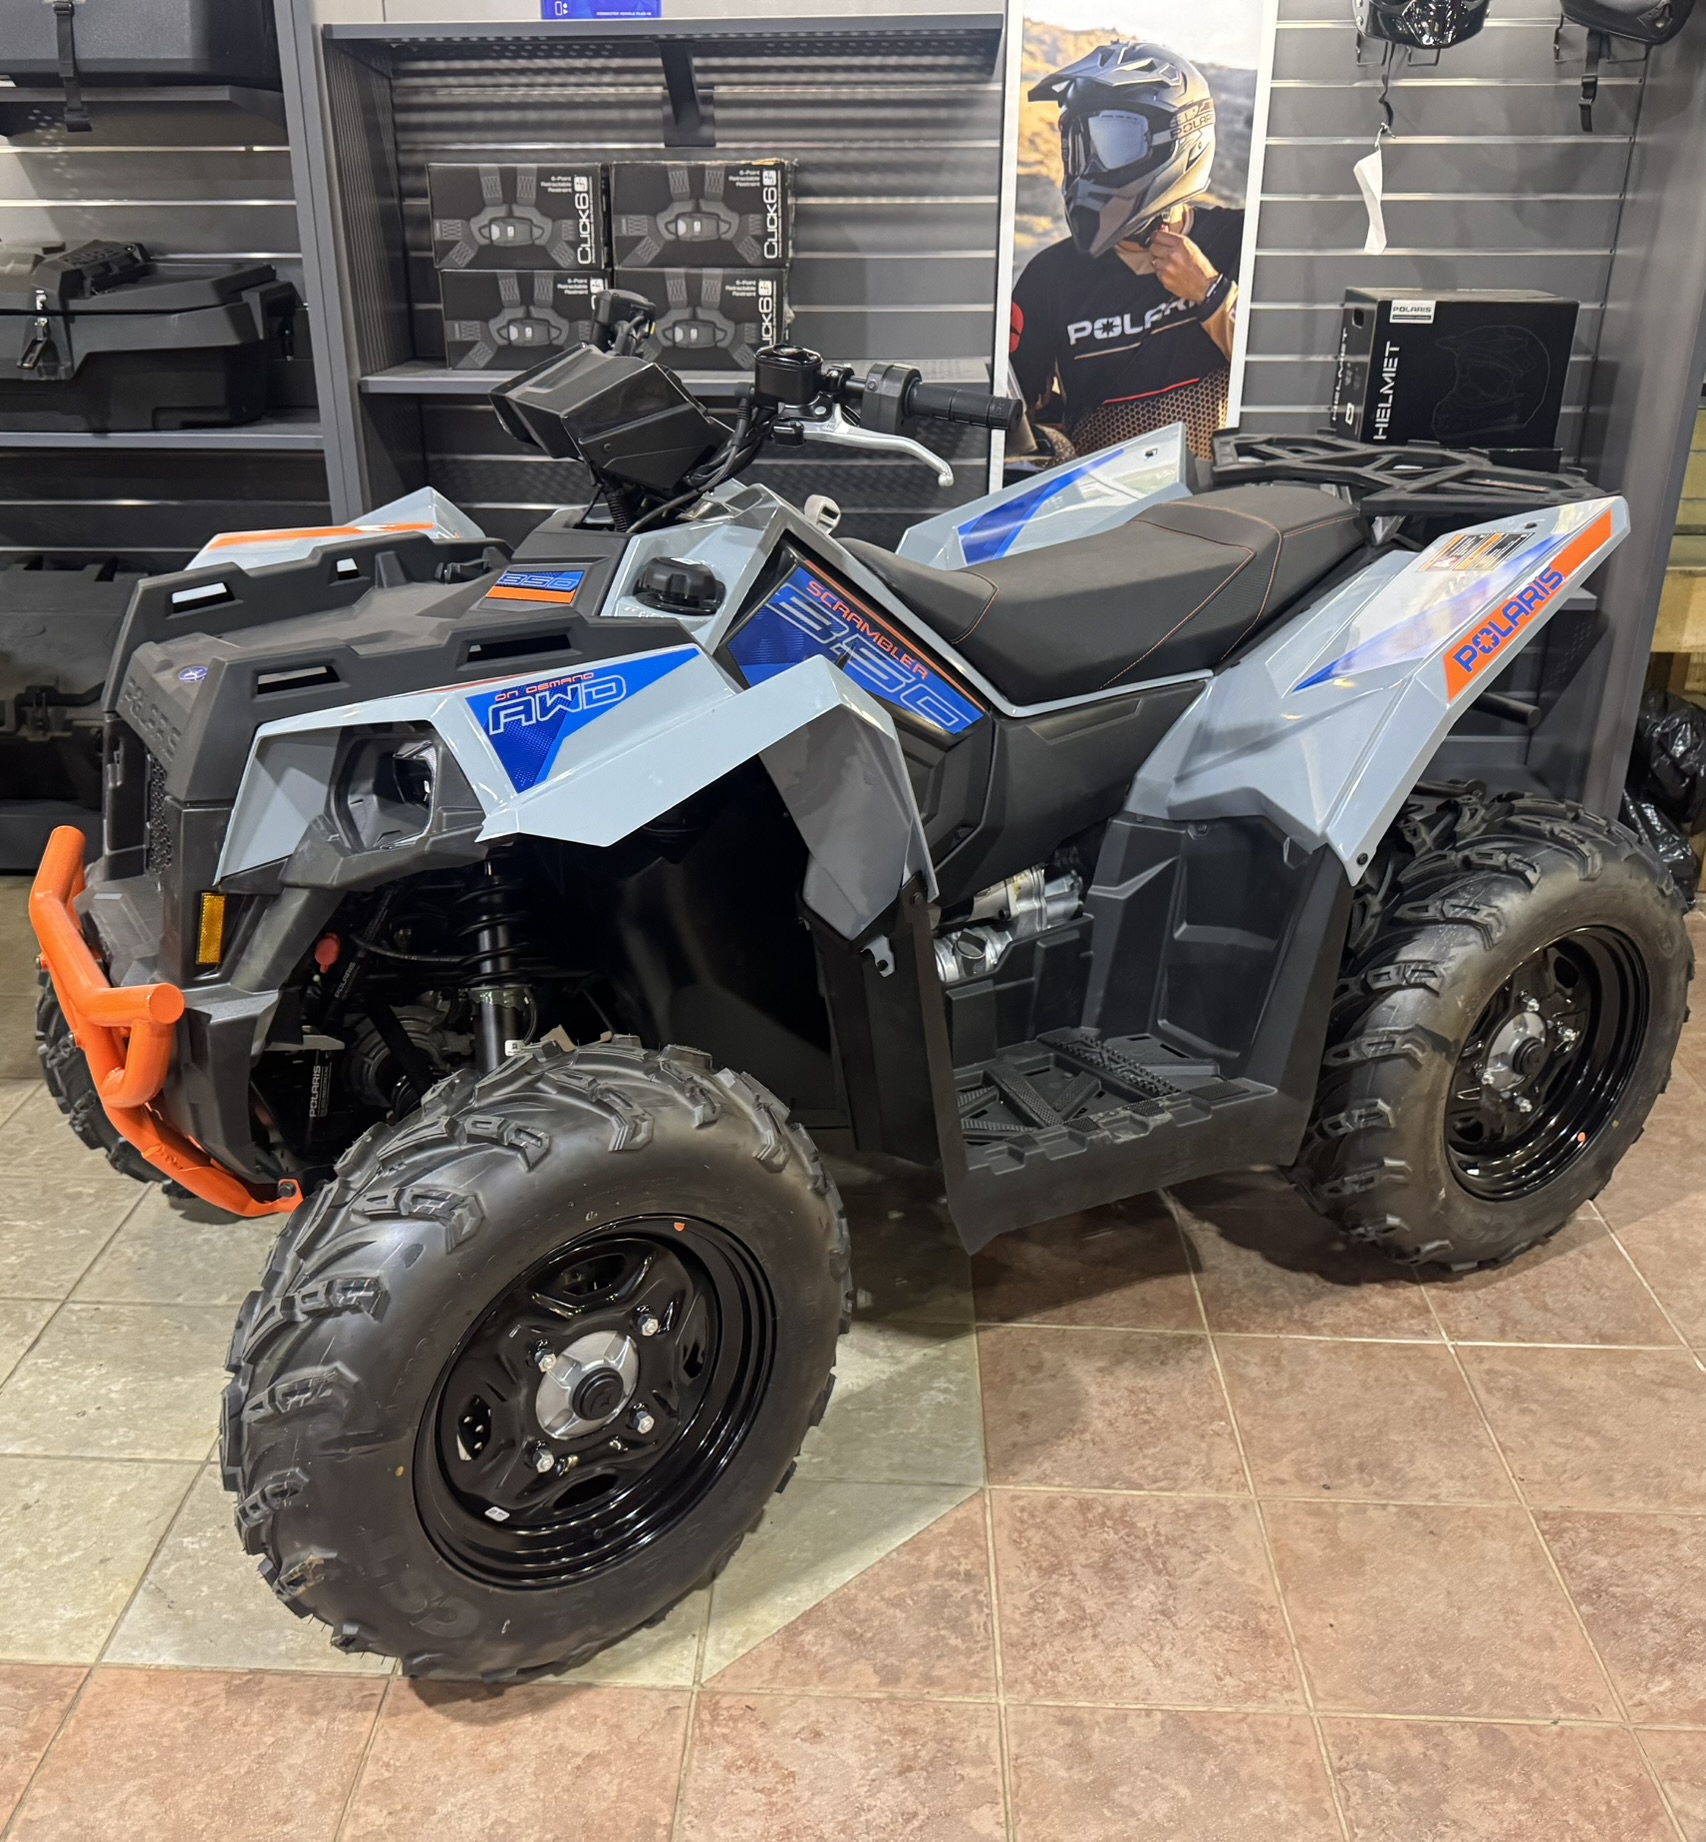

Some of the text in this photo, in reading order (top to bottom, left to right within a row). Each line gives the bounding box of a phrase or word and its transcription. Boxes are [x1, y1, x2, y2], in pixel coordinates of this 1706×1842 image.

[1373, 340, 1400, 440] HELMET
[805, 579, 930, 681] SCRAMBLER
[1452, 563, 1565, 674] POLARIS
[488, 674, 627, 736] AWD
[495, 671, 595, 702] ON DEMAND
[309, 1065, 321, 1118] POLARIS
